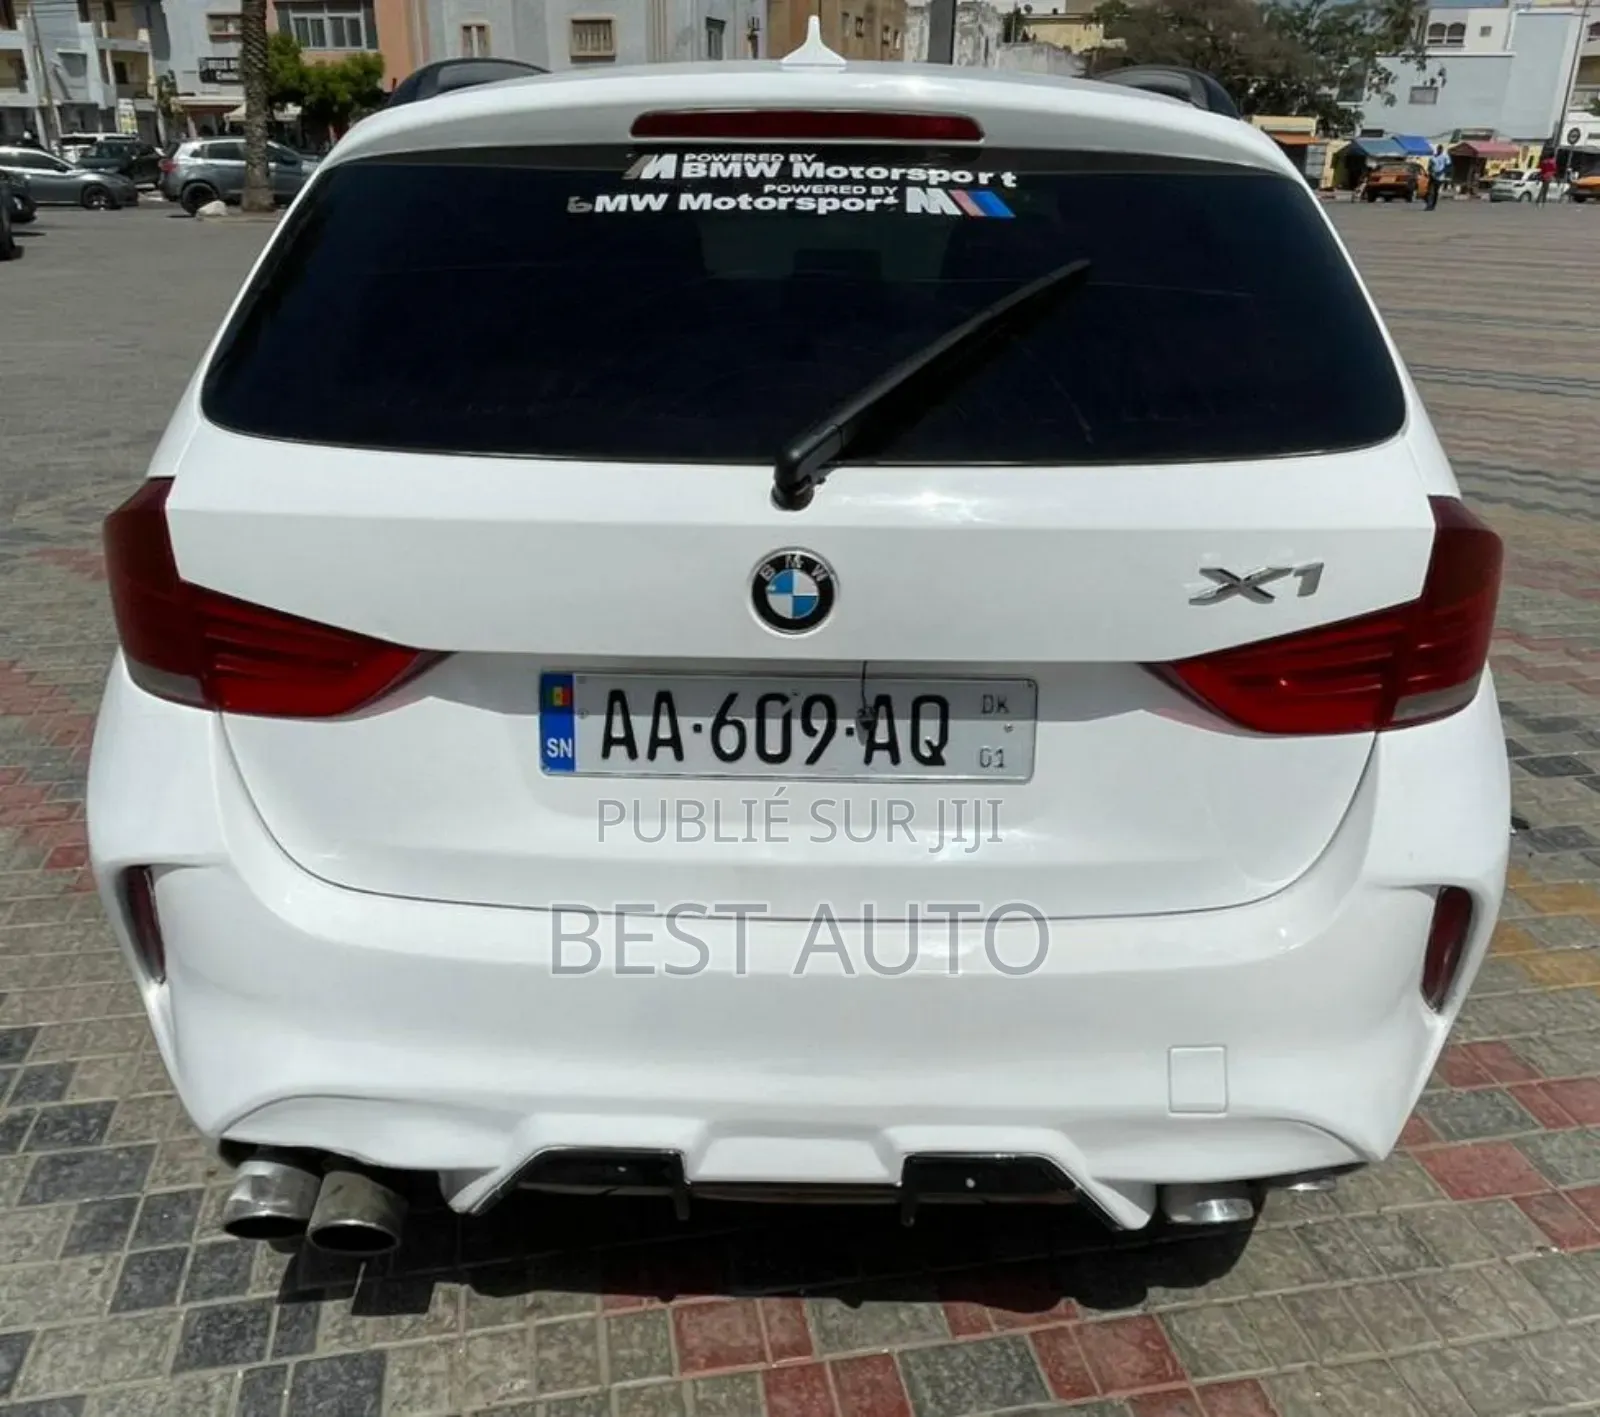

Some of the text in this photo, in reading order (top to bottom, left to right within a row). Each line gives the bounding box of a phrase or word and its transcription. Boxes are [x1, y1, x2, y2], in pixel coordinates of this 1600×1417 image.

[683, 153, 817, 163] POWERED BY
[681, 162, 782, 178] BMW
[763, 184, 899, 196] POWERED BY
[759, 553, 829, 581] BMW
[1188, 562, 1325, 606] X1
[981, 694, 1010, 715] DK
[547, 737, 573, 759] SN
